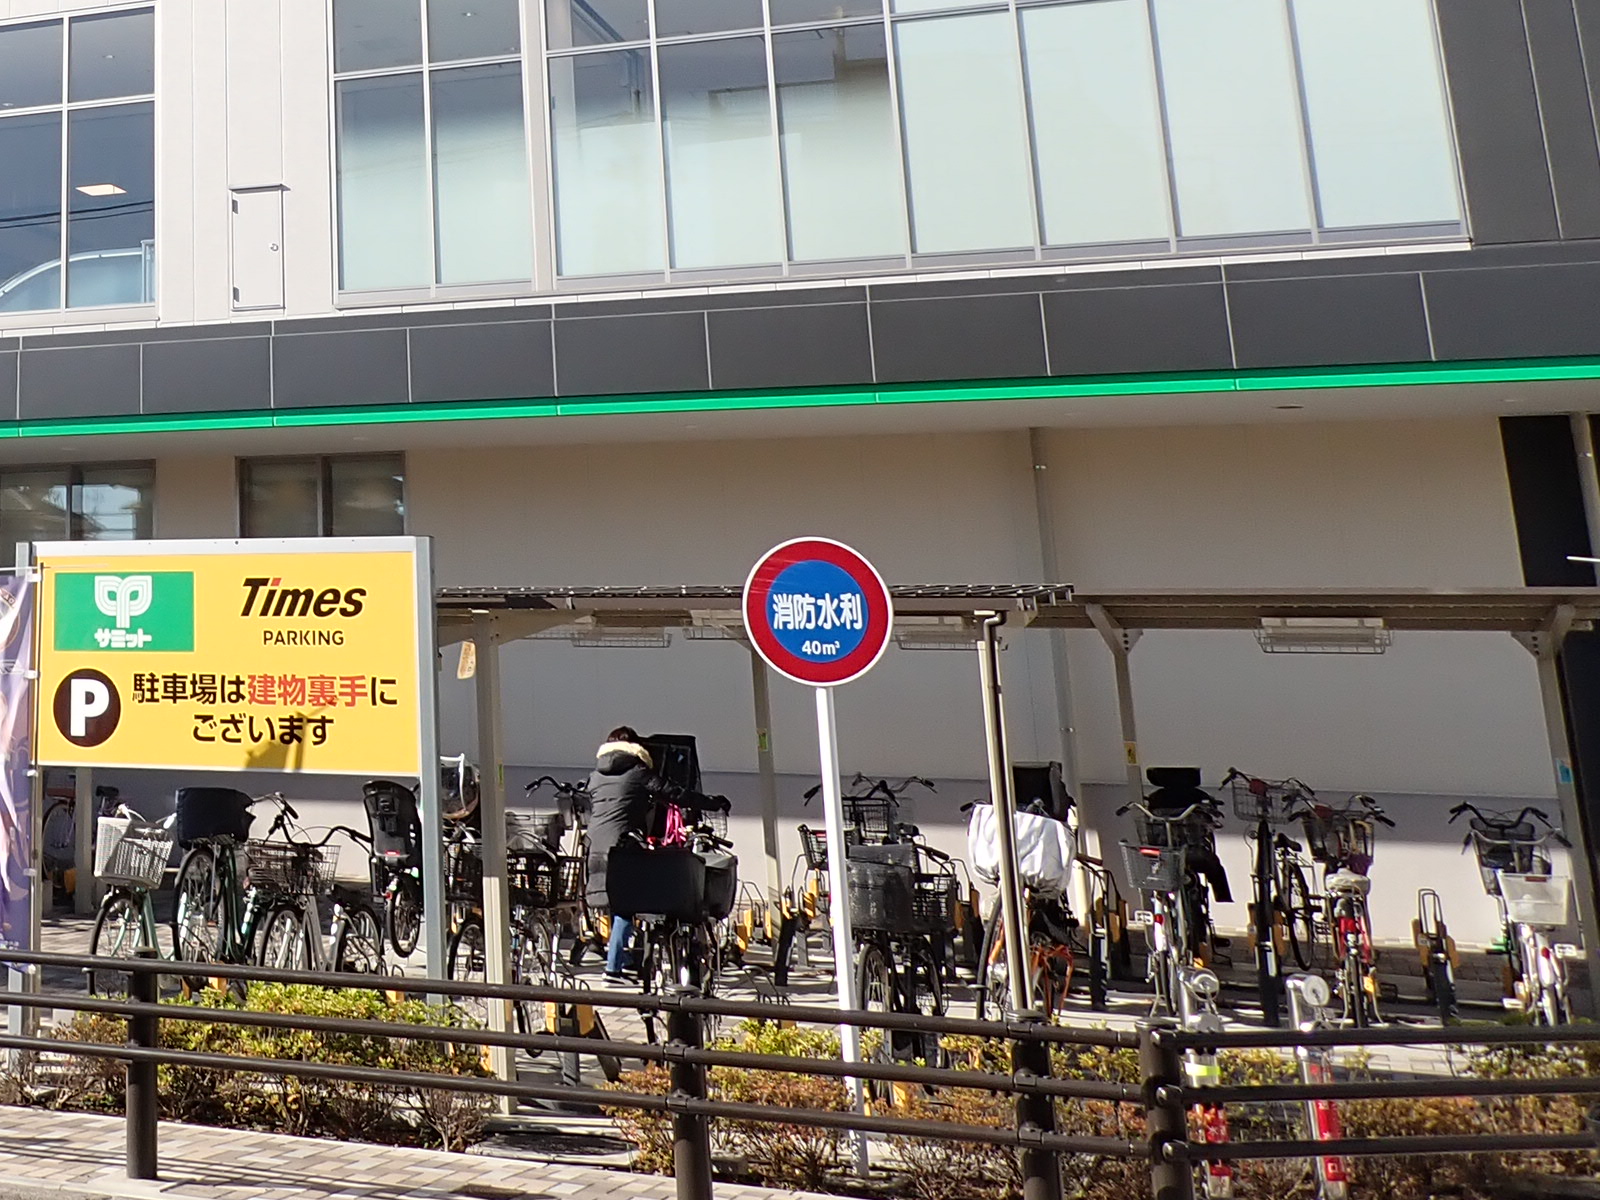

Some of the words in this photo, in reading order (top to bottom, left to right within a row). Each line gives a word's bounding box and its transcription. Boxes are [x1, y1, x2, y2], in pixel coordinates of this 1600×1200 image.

[240, 577, 367, 617] Times
[772, 592, 863, 630] 消防水利
[94, 628, 152, 648] サミット
[263, 630, 344, 646] PARKING
[132, 672, 398, 707] 駐車場は建物裏手に
[70, 678, 110, 737] P
[193, 713, 334, 746] ございます
